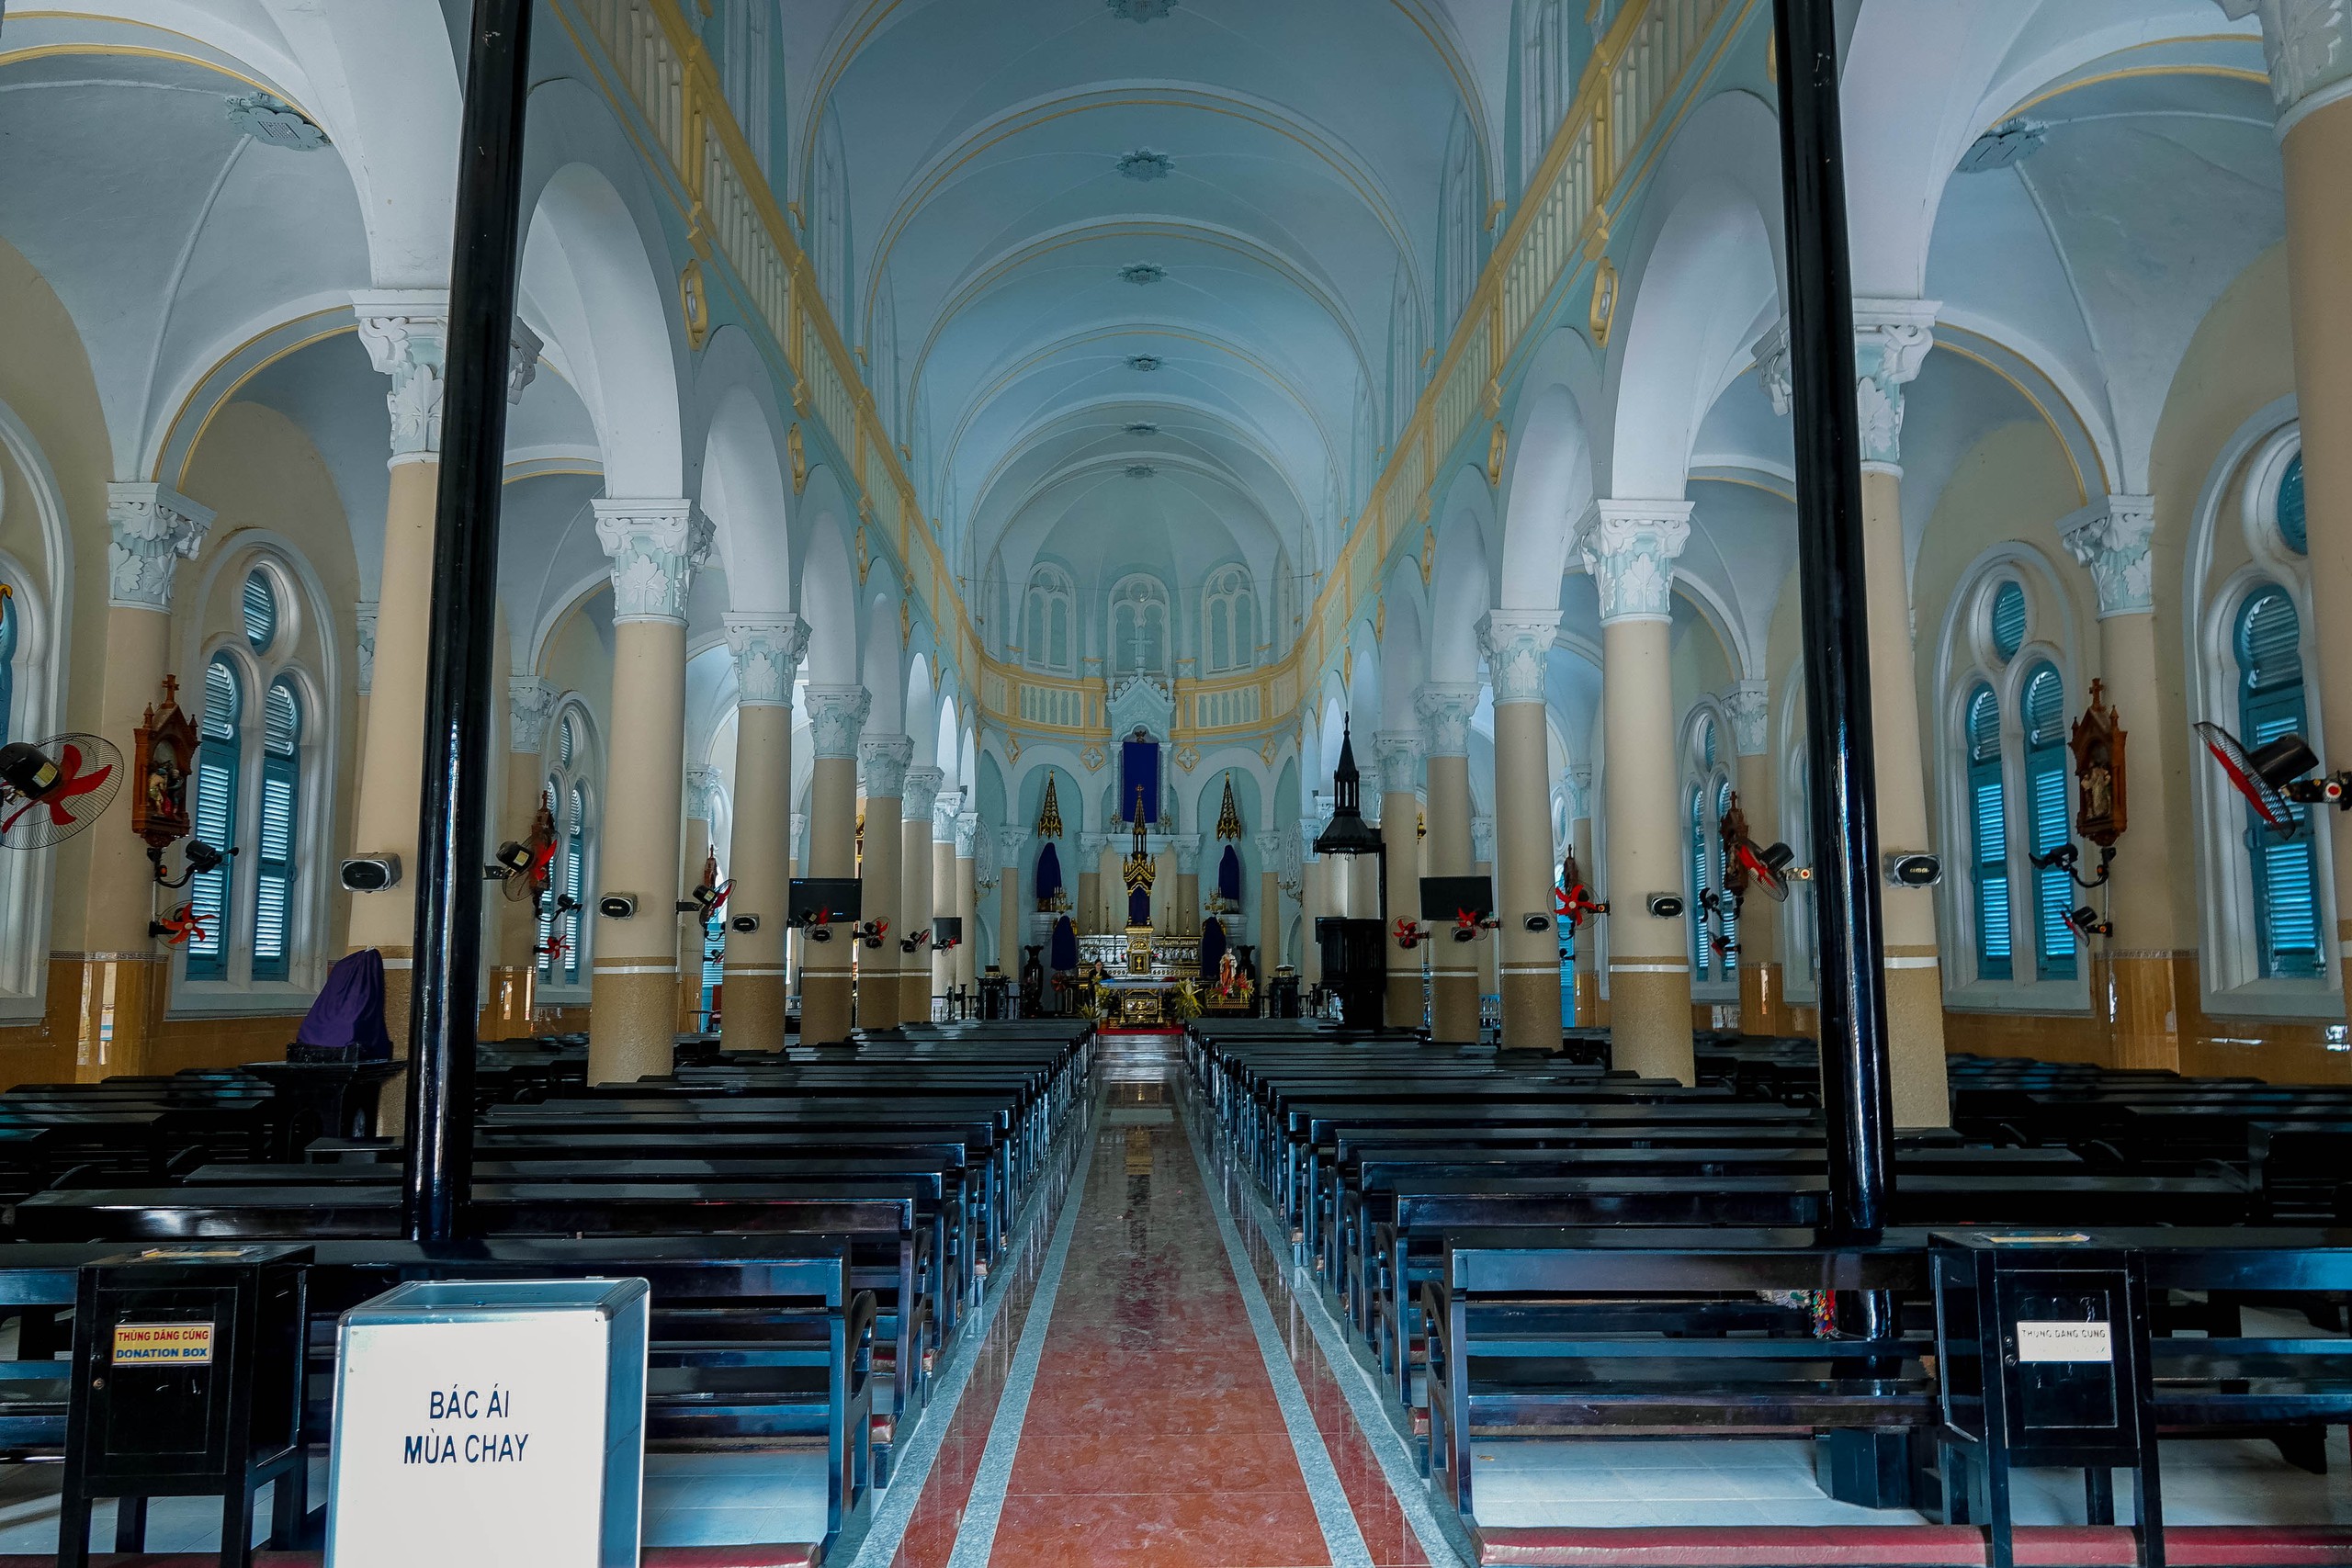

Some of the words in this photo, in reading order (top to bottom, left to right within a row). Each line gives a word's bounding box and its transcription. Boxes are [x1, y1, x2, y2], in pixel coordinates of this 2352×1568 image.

[116, 1348, 179, 1359] DONATION
[182, 1348, 208, 1358] BOX
[429, 1383, 479, 1419] BÁC
[486, 1382, 510, 1418] ÁI
[403, 1427, 457, 1464] MÙA
[465, 1433, 529, 1463] CHAY
